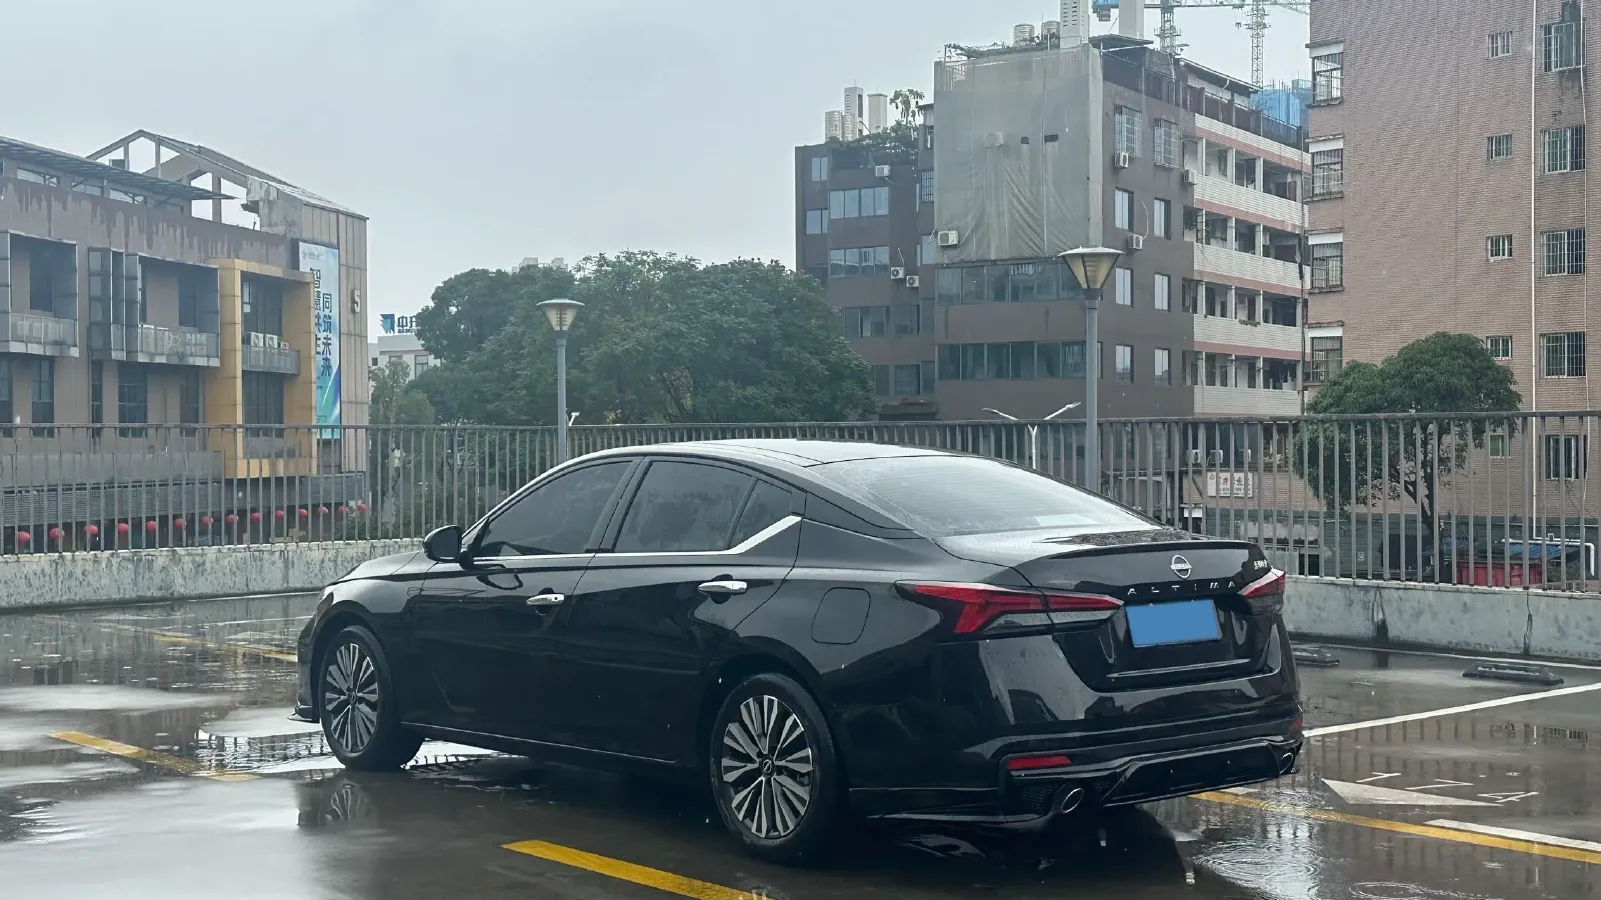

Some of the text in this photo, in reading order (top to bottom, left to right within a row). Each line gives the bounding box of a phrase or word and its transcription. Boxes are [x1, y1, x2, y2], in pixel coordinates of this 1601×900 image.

[321, 293, 333, 377] 同筑未来
[1127, 581, 1236, 596] ALTIMA
